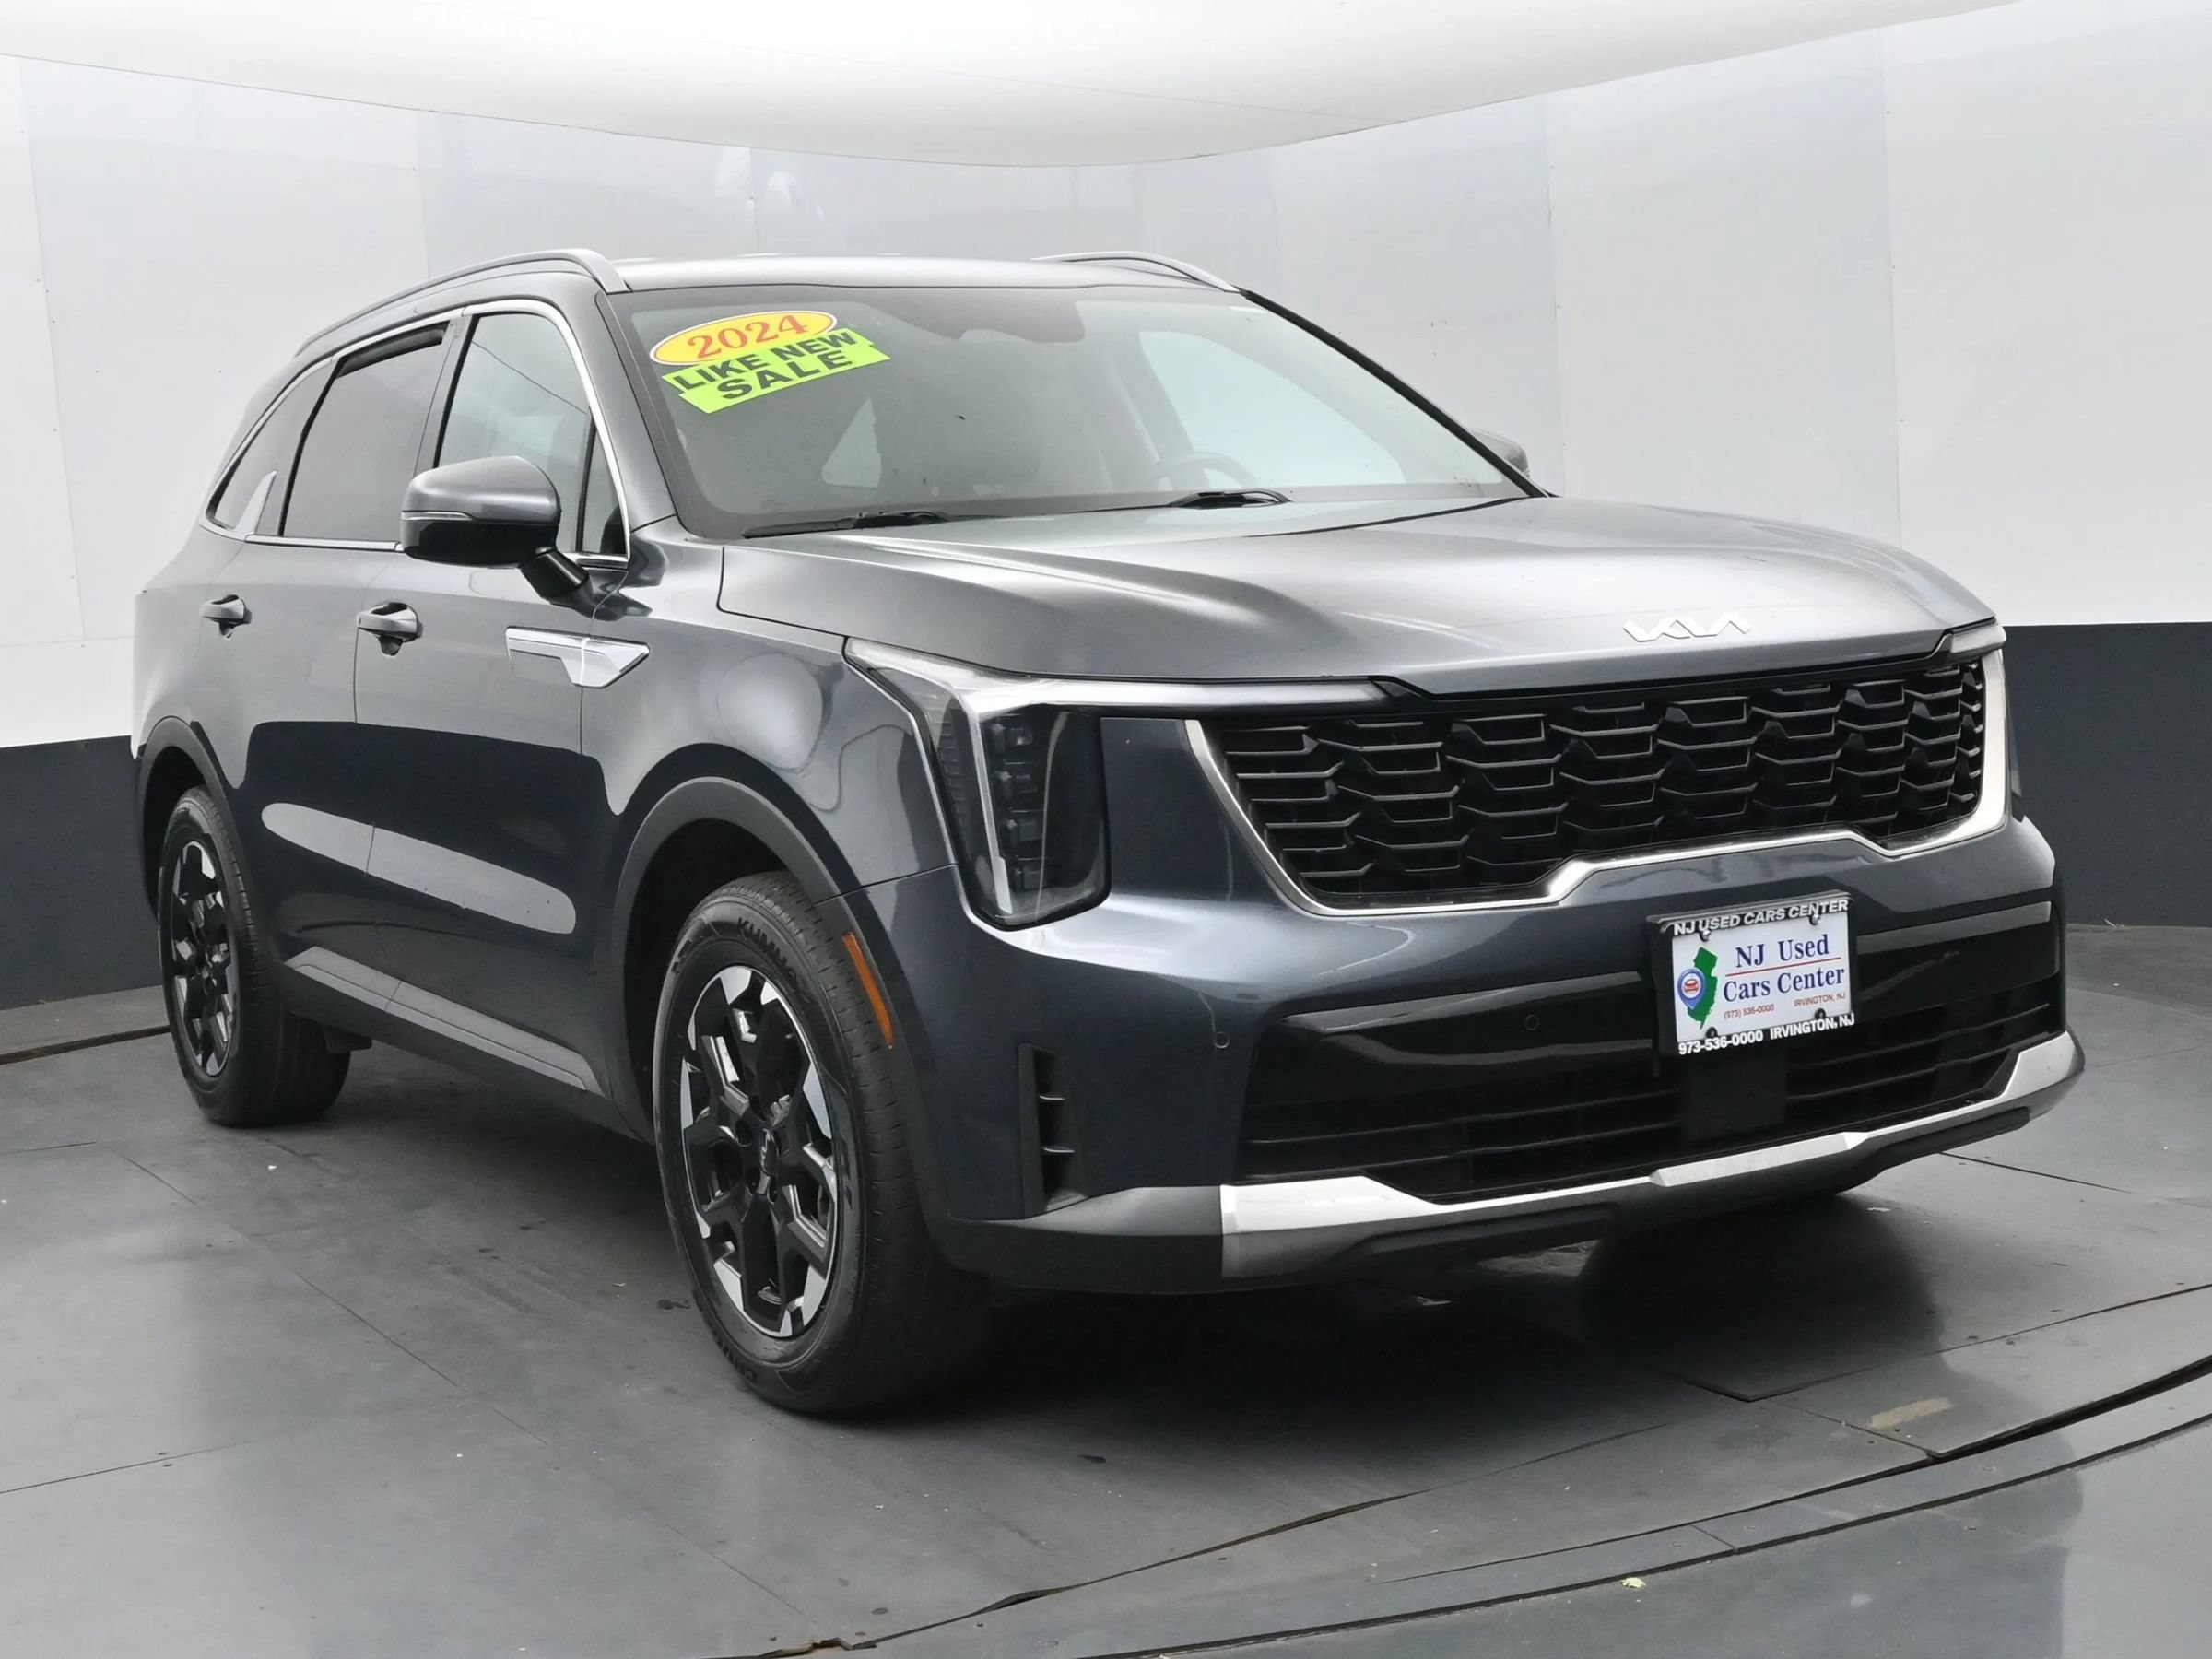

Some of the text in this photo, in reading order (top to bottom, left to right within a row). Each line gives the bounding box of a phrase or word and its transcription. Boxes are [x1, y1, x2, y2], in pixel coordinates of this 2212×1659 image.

[687, 314, 808, 359] 2024
[673, 331, 858, 391] LIKE NEW
[717, 350, 853, 400] SALE
[1673, 899, 1849, 935] NJ USED CARS CENTER
[737, 917, 798, 991] KUMHO
[1735, 934, 1830, 968] NJ Used
[1724, 967, 1845, 1002] Cars Center
[1794, 992, 1846, 1007] IRVINGTON, NJ
[1724, 1004, 1775, 1020] (973) 536-0000
[1678, 1012, 1855, 1055] 973-536-0000 IRVINGTON, NJ
